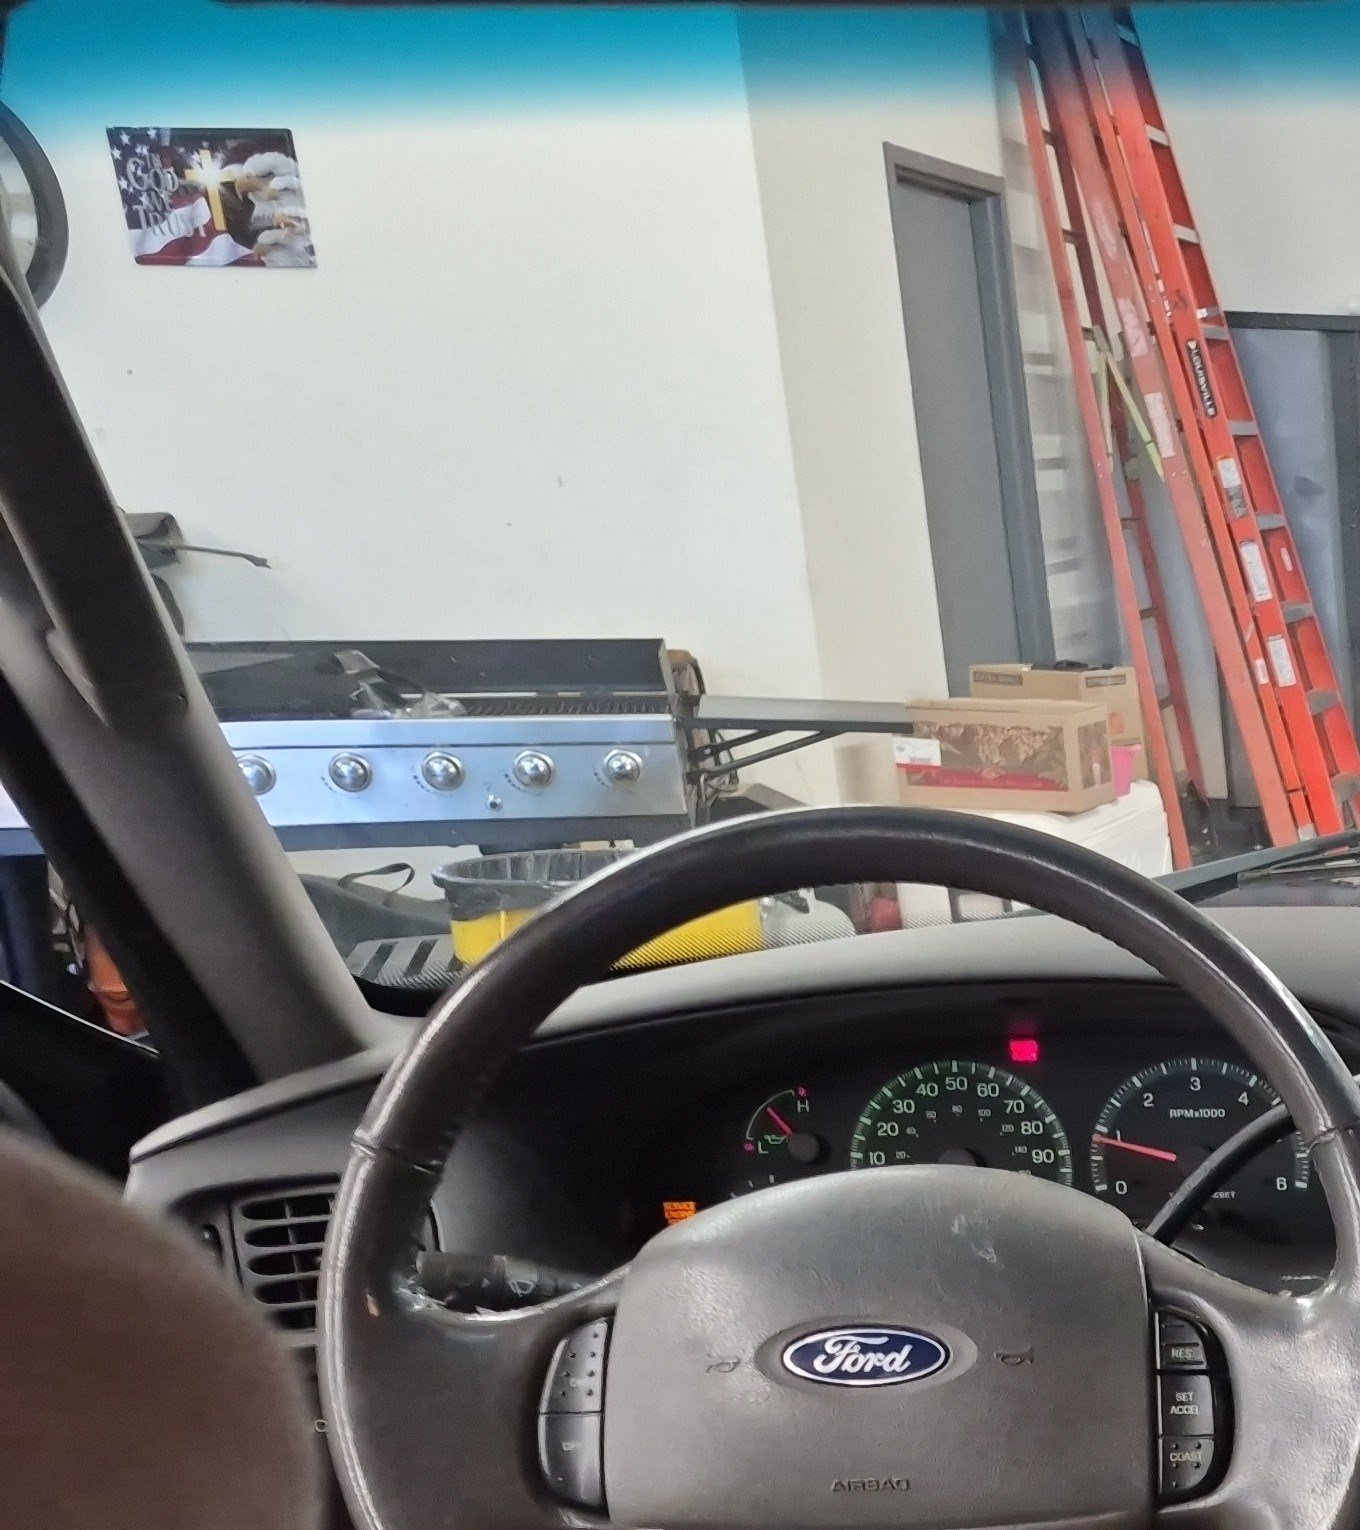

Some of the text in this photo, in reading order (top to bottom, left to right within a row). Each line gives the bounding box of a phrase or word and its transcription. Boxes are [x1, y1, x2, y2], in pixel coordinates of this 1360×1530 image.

[916, 1082, 938, 1097] 40
[945, 1076, 967, 1091] 50
[976, 1083, 999, 1098] 60
[1189, 1076, 1201, 1091] 3
[797, 1099, 809, 1113] H
[1142, 1093, 1155, 1108] 2
[1237, 1091, 1249, 1106] 4
[893, 1099, 915, 1114] 30
[1004, 1099, 1025, 1114] 70
[877, 1122, 899, 1137] 20
[1020, 1120, 1043, 1135] 80
[757, 1141, 769, 1154] L
[869, 1151, 886, 1166] 10
[1031, 1149, 1055, 1164] 90
[1115, 1180, 1127, 1195] 0
[1276, 1176, 1288, 1191] 6
[813, 1336, 913, 1374] Ford
[1171, 1348, 1193, 1359] RES
[1175, 1392, 1194, 1402] SET
[1169, 1405, 1200, 1415] ACCEL
[1169, 1452, 1202, 1462] COAST
[832, 1476, 911, 1493] AIRBAG
